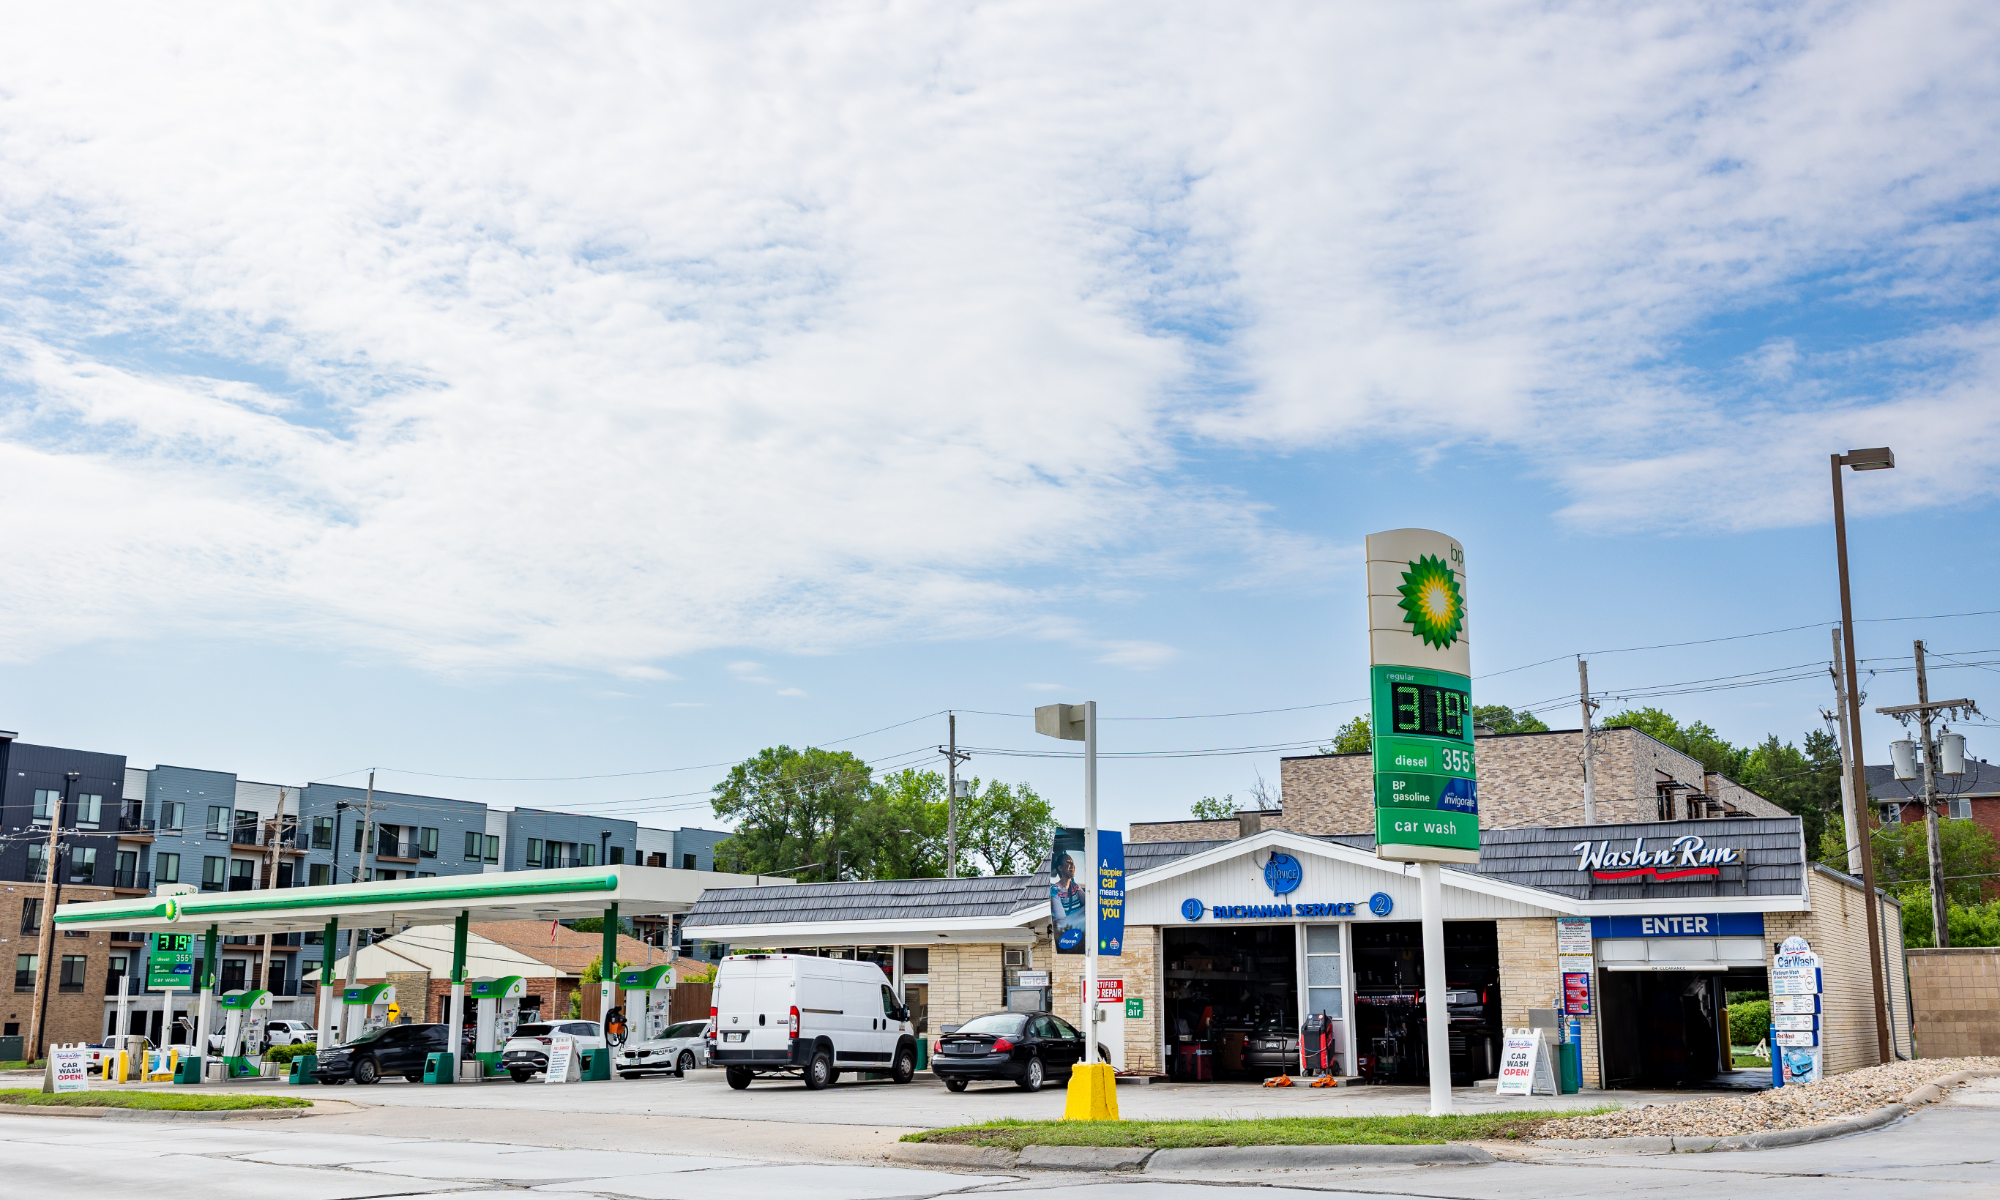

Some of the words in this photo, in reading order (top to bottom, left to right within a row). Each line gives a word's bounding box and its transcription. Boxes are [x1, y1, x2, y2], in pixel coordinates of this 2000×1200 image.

[1450, 543, 1464, 567] bp
[1386, 672, 1414, 681] regular
[1395, 754, 1428, 767] diesel
[1392, 780, 1406, 790] BP
[1393, 792, 1430, 802] gasoline
[1394, 821, 1418, 832] car
[1424, 820, 1456, 834] wash
[1572, 837, 1653, 872] Wash
[1672, 836, 1738, 868] Run
[1102, 858, 1108, 868] A
[1100, 866, 1123, 878] happier
[1102, 878, 1116, 888] car
[1100, 888, 1118, 896] means
[1100, 896, 1123, 906] happier
[1213, 904, 1292, 919] BUCHANAN
[1296, 902, 1356, 917] SERVICE
[1375, 897, 1386, 913] 2
[1102, 907, 1120, 920] you
[1642, 916, 1709, 934] ENTER
[1102, 988, 1122, 998] REPAIR
[1128, 1006, 1141, 1016] air
